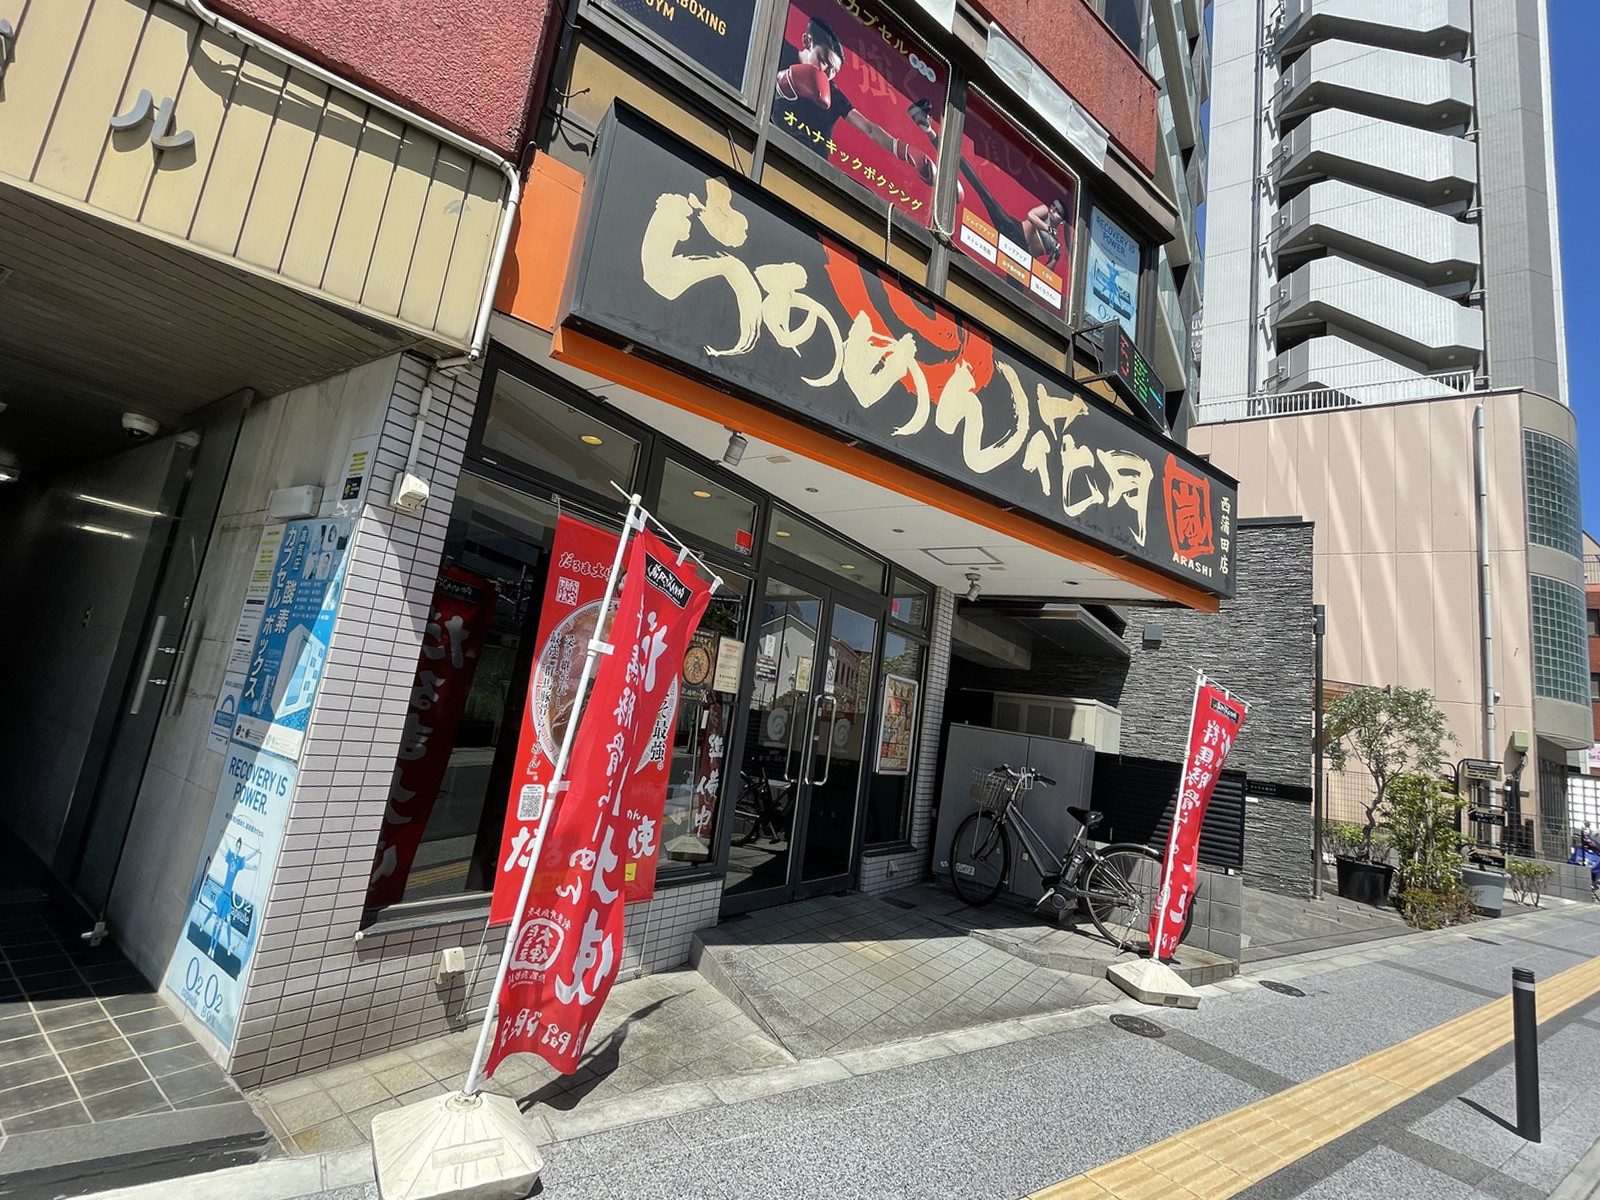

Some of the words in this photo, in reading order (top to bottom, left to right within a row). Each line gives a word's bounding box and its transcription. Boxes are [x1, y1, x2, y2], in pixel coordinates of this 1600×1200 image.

[676, 0, 727, 36] BOXING
[783, 110, 923, 211] オハナキックボクシング
[1219, 496, 1231, 575] 西蒲田店
[1172, 552, 1212, 578] ARASHI
[228, 756, 277, 792] RECOVERY
[275, 774, 289, 798] IS
[233, 782, 268, 816] POWER.
